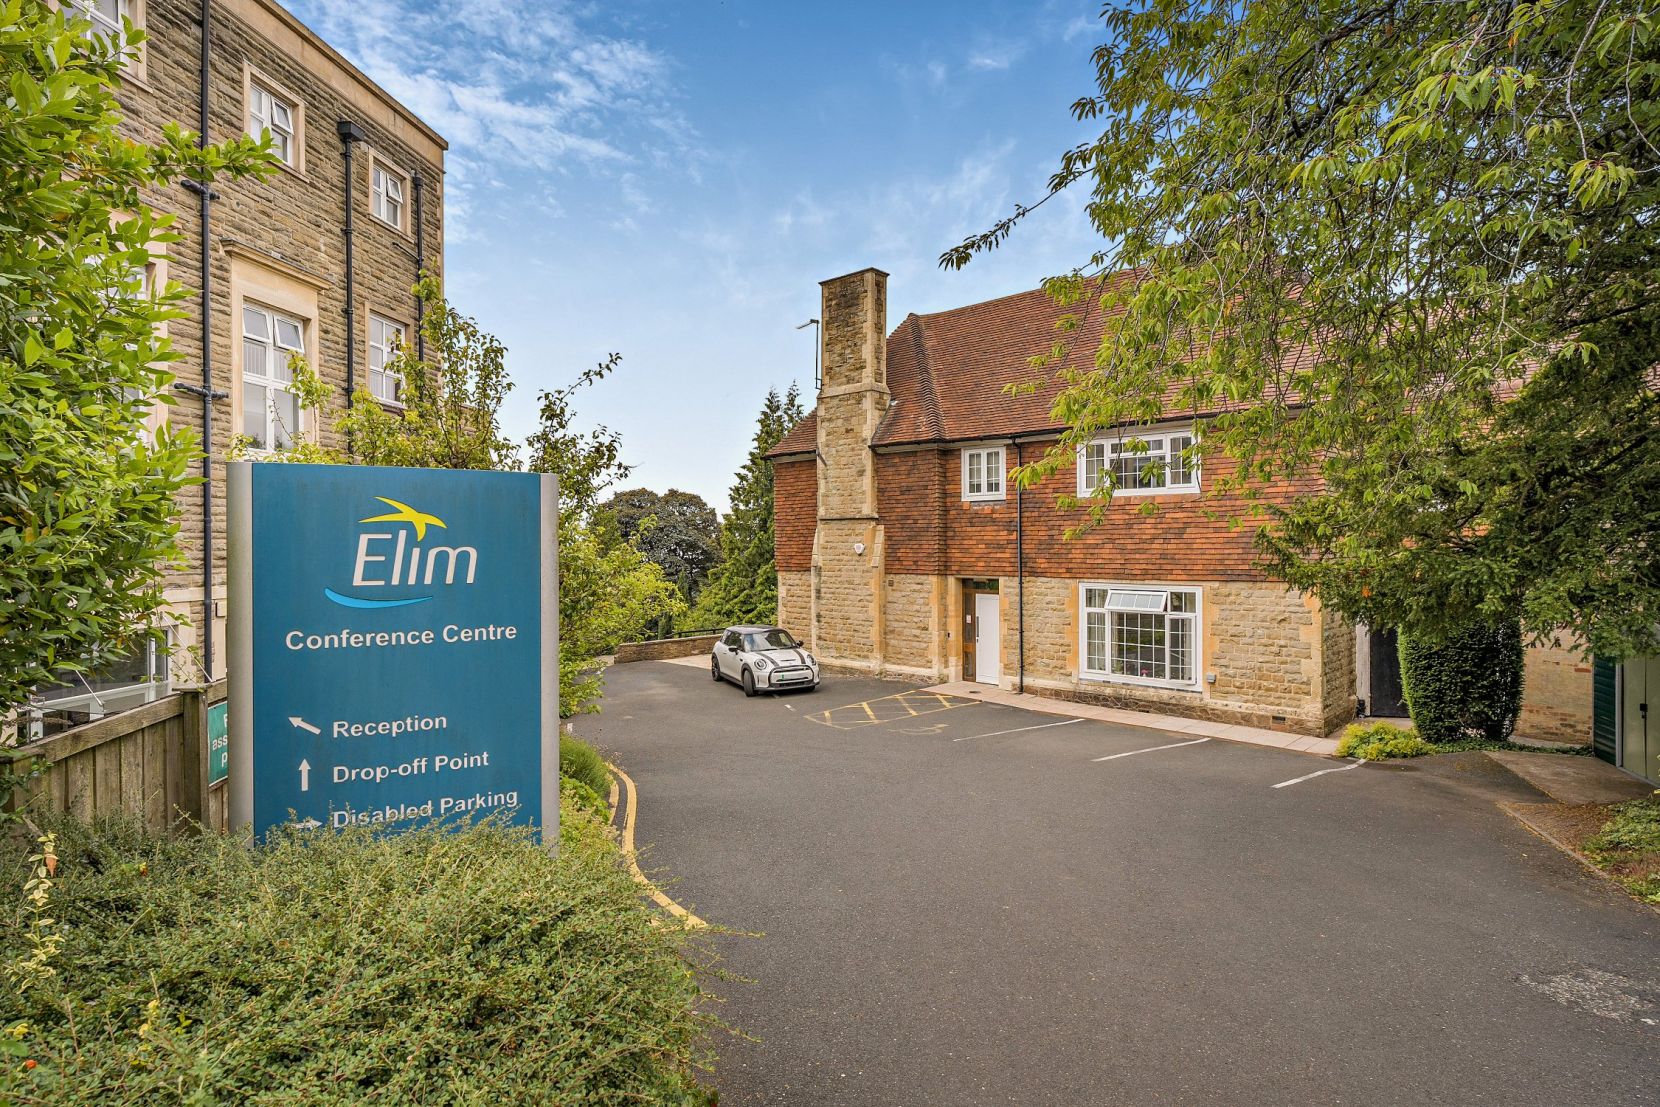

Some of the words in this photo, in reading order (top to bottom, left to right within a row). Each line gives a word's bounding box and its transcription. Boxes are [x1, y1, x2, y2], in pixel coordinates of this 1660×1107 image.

[353, 530, 478, 586] Elim
[285, 629, 435, 650] Conference
[442, 624, 517, 643] Centre
[332, 715, 447, 738] Reception
[332, 756, 428, 783] Drop-off
[434, 751, 489, 772] Point
[332, 800, 433, 828] Disabled
[440, 791, 518, 814] Parking
